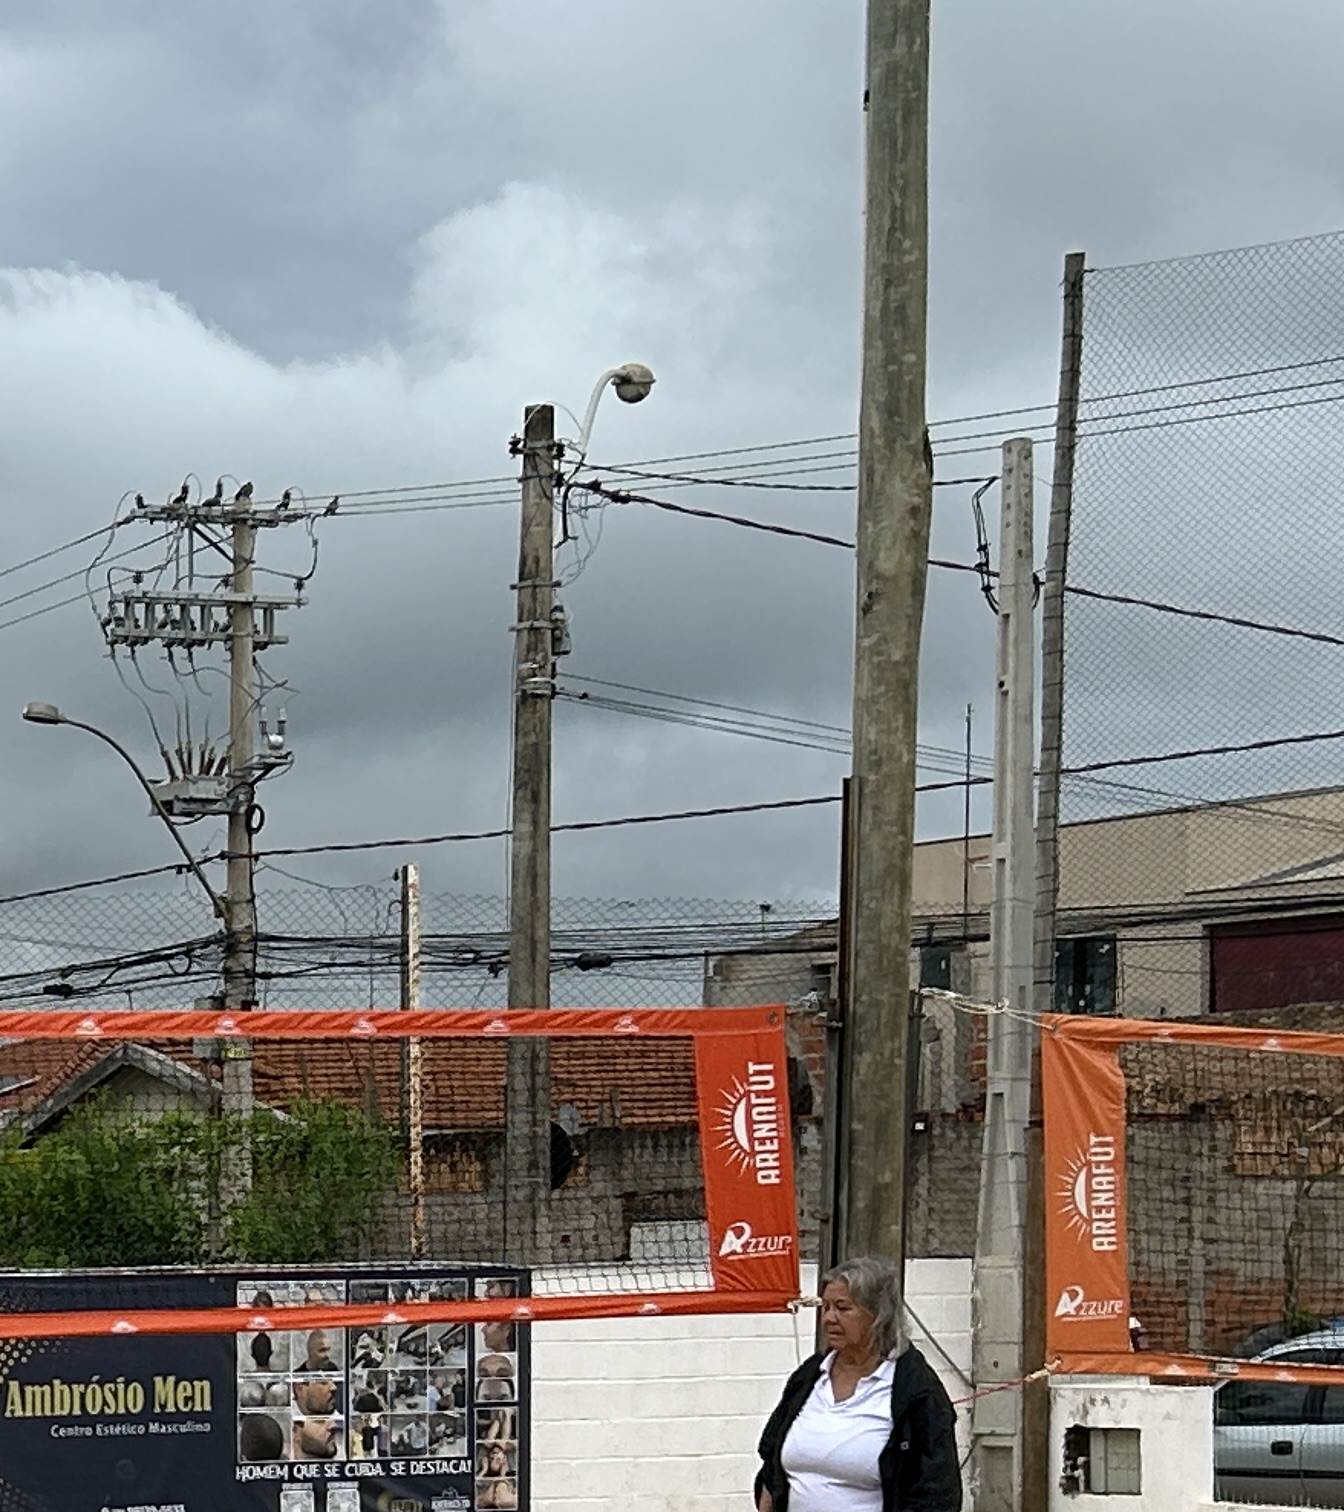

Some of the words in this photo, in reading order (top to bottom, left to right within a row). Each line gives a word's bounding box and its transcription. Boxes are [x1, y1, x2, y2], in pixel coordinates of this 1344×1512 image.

[748, 1061, 781, 1185] ARENAFUT
[1087, 1132, 1118, 1251] ARENAFUT
[4, 1374, 145, 1418] Ambrósio
[153, 1374, 212, 1414] Men
[50, 1423, 93, 1438] Centro
[96, 1421, 145, 1437] Estético
[148, 1419, 211, 1435] Masculino
[235, 1463, 289, 1482] HOMEM
[293, 1463, 321, 1480] QUE
[323, 1462, 342, 1478] SE
[390, 1461, 407, 1477] SE
[410, 1459, 473, 1476] DESTACA!
